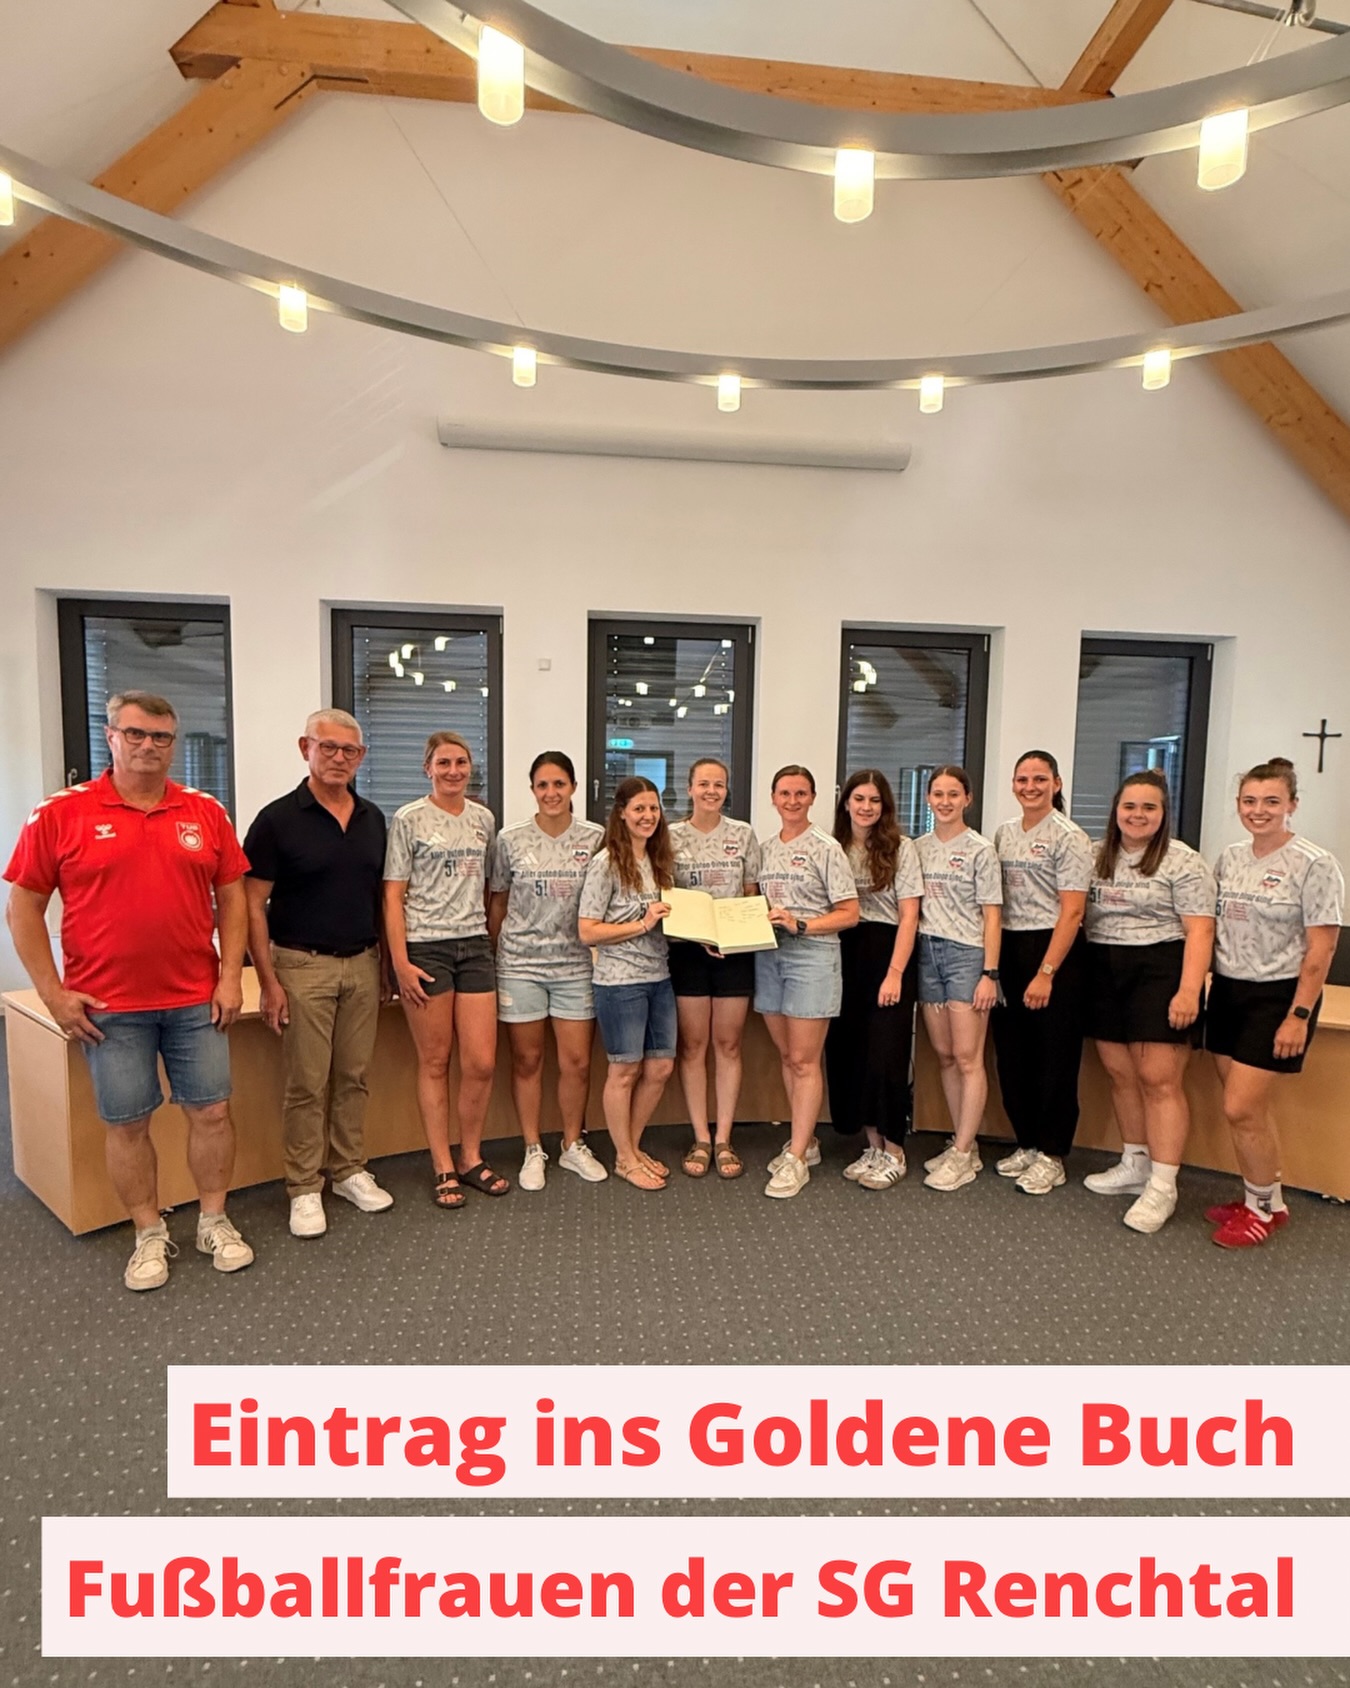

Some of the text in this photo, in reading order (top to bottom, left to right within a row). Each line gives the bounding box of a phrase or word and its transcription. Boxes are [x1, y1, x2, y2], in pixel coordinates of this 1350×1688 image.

[444, 859, 458, 877] 5!
[535, 879, 548, 897] 5!
[690, 871, 702, 887] 5!
